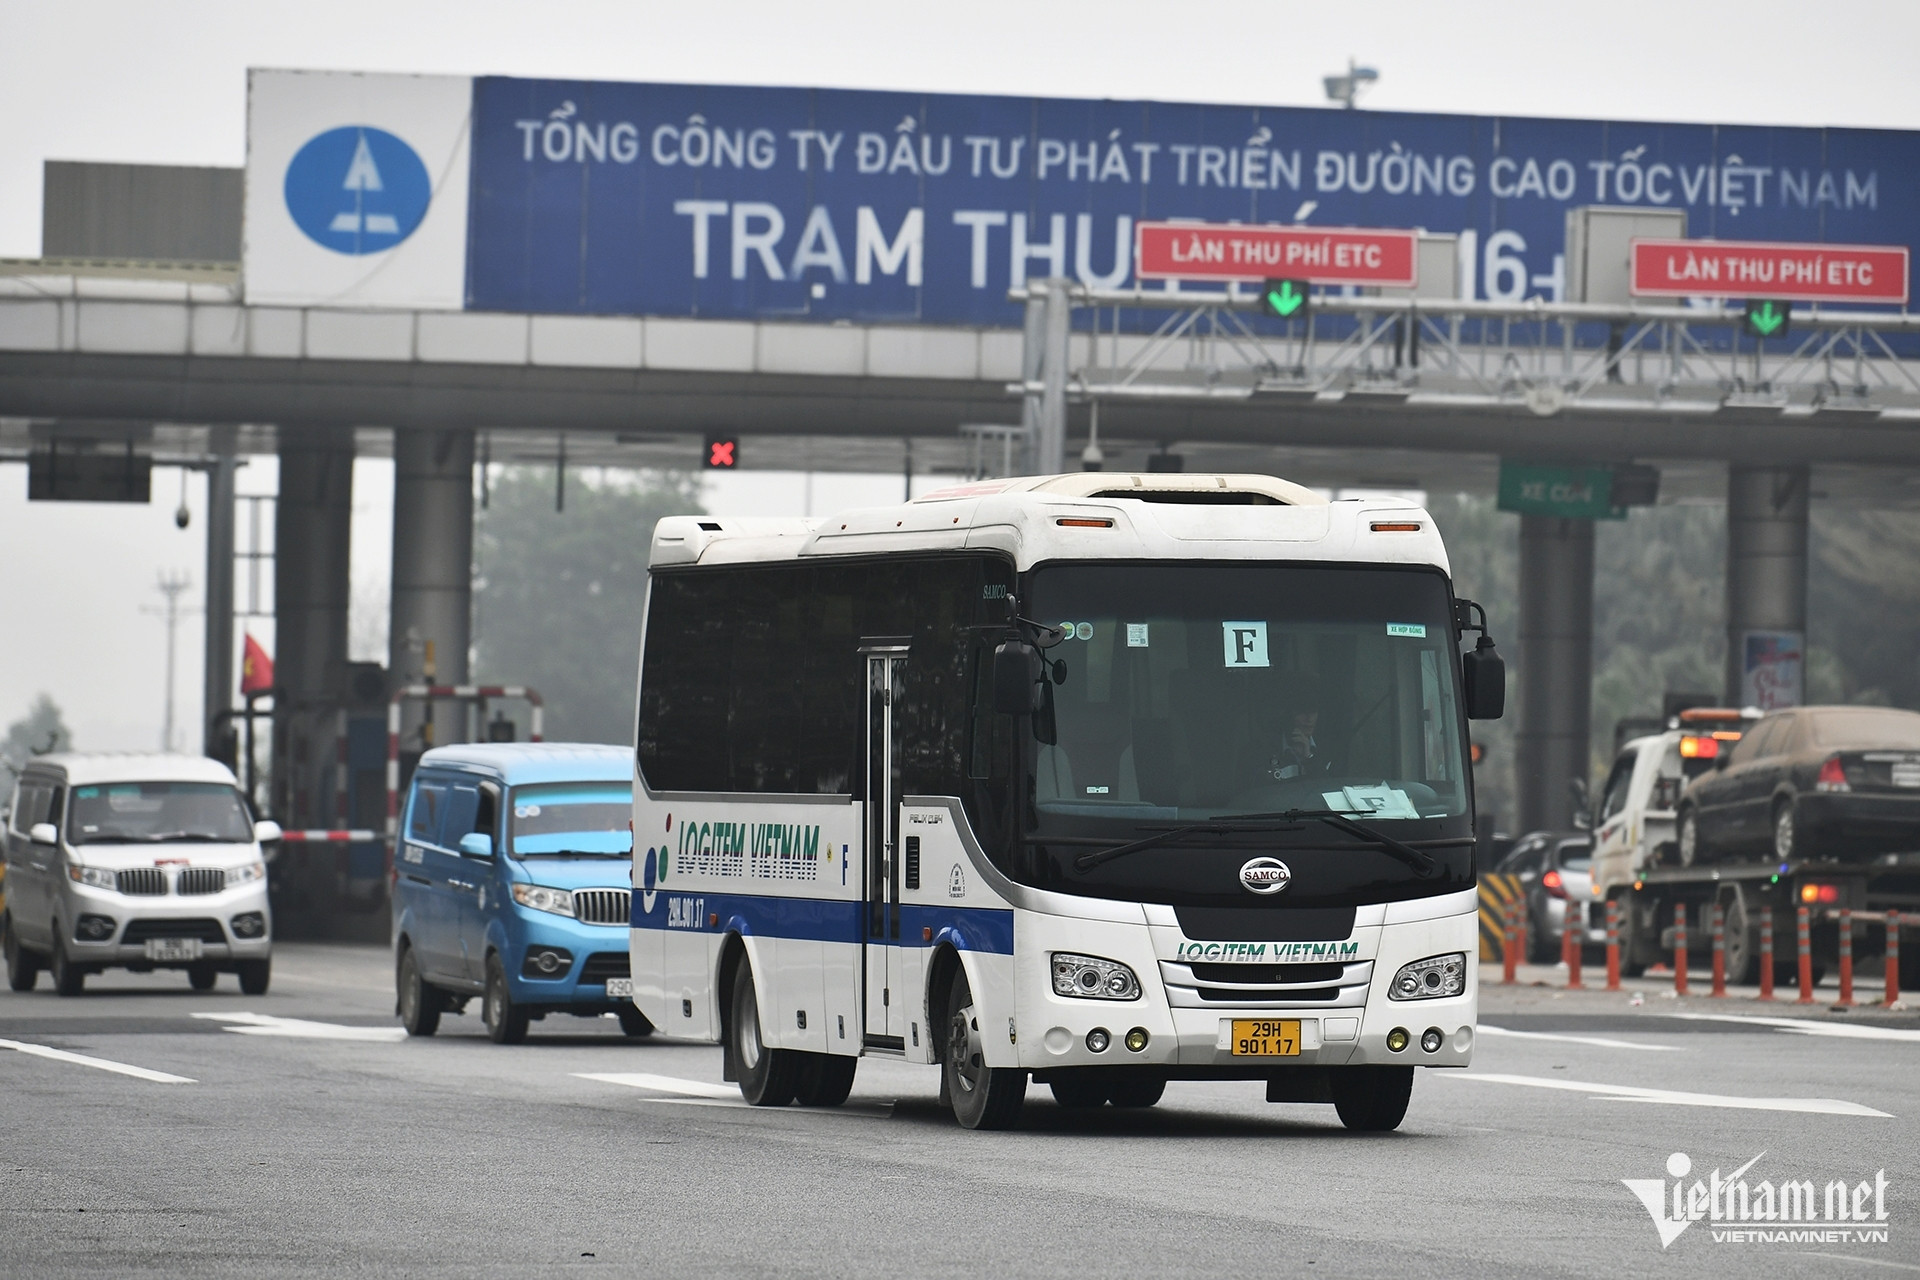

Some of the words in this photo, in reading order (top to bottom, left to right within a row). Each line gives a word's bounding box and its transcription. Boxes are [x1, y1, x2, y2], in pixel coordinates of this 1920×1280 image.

[515, 100, 639, 163] TỔNG
[651, 114, 776, 169] CÔNG
[789, 131, 843, 171] TY
[856, 115, 951, 176] ĐẦU
[964, 135, 1026, 179] TƯ
[1038, 128, 1160, 184] PHÁT
[1170, 127, 1302, 190] TRIỂN
[1315, 141, 1475, 197] ĐƯỜNG
[1489, 157, 1577, 200] CAO
[1588, 143, 1673, 204] TỐC
[1679, 153, 1773, 216] VIỆT
[1780, 168, 1880, 211] NAM
[674, 200, 924, 299] TRẠM
[953, 210, 1132, 290] THU
[1171, 232, 1224, 264] LÀN
[1229, 239, 1281, 266] THU
[1286, 237, 1330, 268] PHÍ
[1334, 242, 1382, 269] ETC
[1667, 250, 1719, 281] LÀN
[1724, 257, 1775, 284] THU
[1779, 254, 1823, 286] PHÍ
[1827, 261, 1874, 287] ETC
[982, 584, 1007, 600] SAMCO
[1232, 629, 1257, 663] F
[677, 820, 746, 877] LOGITEM
[751, 823, 820, 881] VIETNAM
[842, 844, 849, 886] F
[1244, 871, 1287, 881] SAMCO
[1176, 942, 1266, 962] LOGITEM
[1273, 942, 1359, 962] VIETNAM
[1239, 1039, 1293, 1054] 901.17
[1252, 1023, 1281, 1037] 29H
